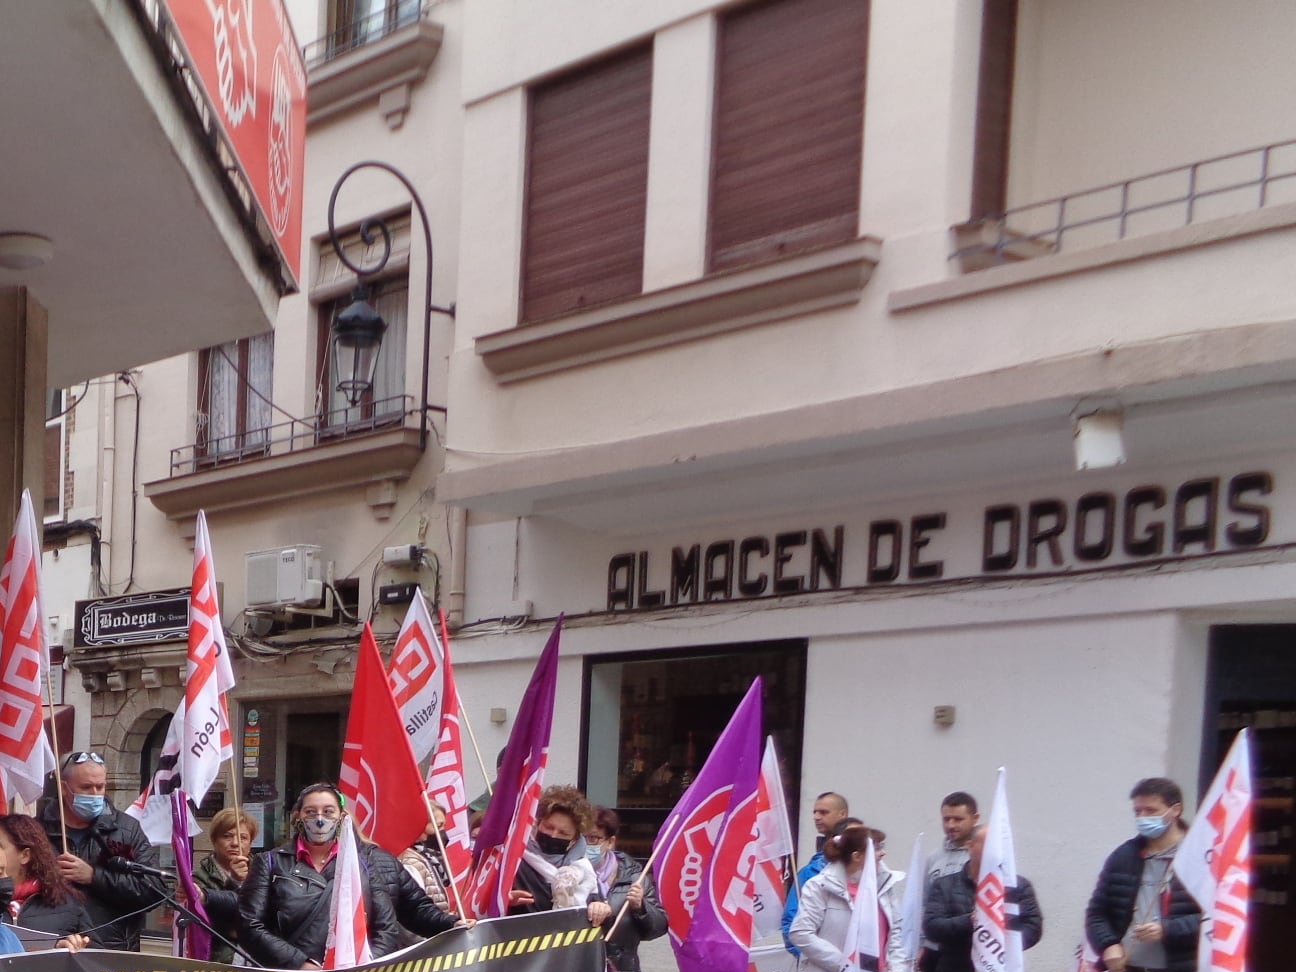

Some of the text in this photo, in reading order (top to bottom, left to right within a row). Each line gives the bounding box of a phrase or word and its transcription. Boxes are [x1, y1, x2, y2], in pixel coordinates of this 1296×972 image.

[607, 471, 1274, 611] ALMACEN DE DROGAS
[100, 612, 157, 628] Bodega
